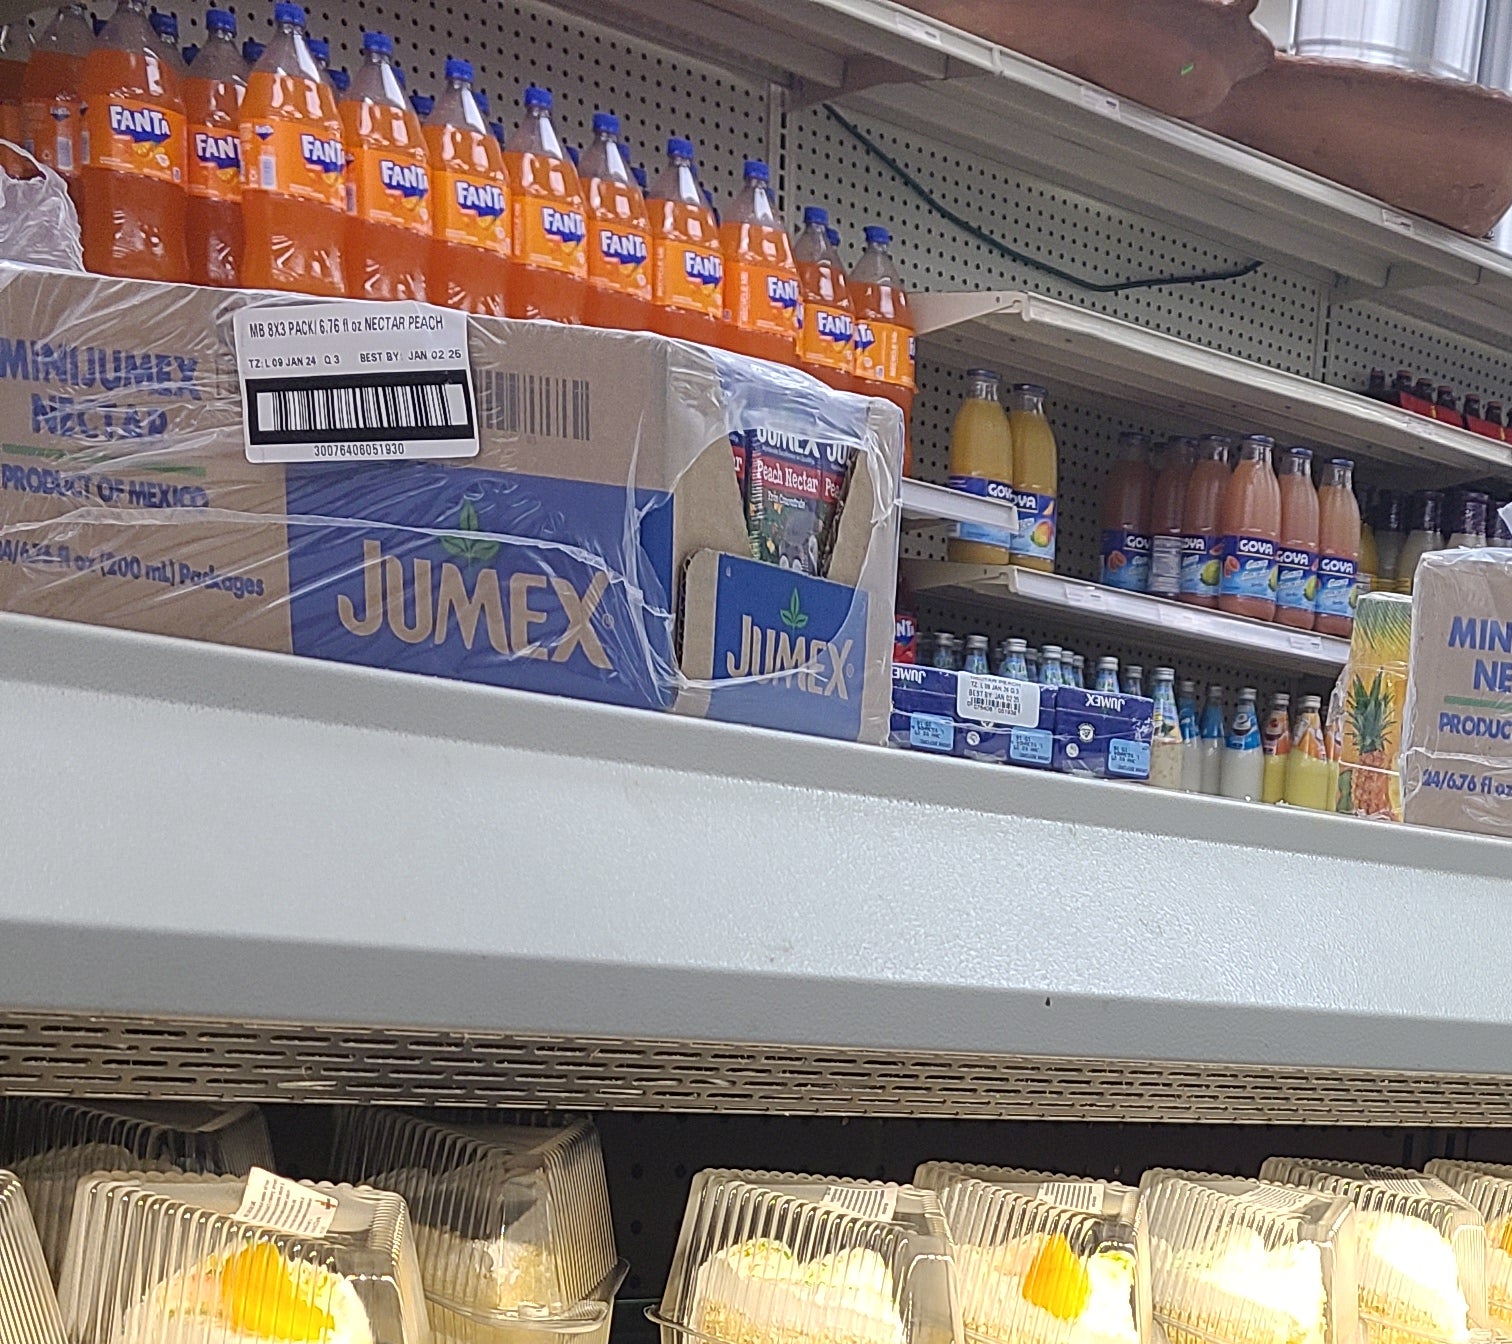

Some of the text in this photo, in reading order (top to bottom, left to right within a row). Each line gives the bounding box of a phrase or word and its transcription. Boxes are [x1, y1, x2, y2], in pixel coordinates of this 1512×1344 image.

[109, 104, 170, 136] FANTA
[196, 133, 241, 160] FANT
[767, 275, 799, 301] FANT
[249, 323, 266, 339] MB
[267, 321, 287, 338] 8X3
[319, 318, 341, 335] 6.76
[351, 320, 363, 333] oz
[364, 316, 406, 332] NECTAR
[408, 315, 444, 331] PEACH
[817, 310, 852, 336] FANT
[285, 356, 304, 367] JAN
[305, 356, 317, 366] 24
[323, 355, 332, 366] Q
[333, 354, 340, 365] 3
[360, 351, 384, 363] BEST
[408, 349, 428, 361] JAN
[431, 350, 446, 360] 02
[2, 463, 210, 508] PRODUCT OF MEXICO
[756, 459, 784, 485] Peach
[785, 466, 818, 493] Nectar
[1238, 538, 1274, 556] GOYA
[1276, 550, 1309, 566] GOYA
[99, 553, 141, 581] (200
[145, 559, 175, 586] mL)
[1320, 558, 1354, 575] GOYA
[338, 539, 614, 671] JUMEX
[727, 614, 854, 700] JUMEX
[1085, 692, 1126, 712] JUMEX
[1422, 768, 1478, 793] 24/6.76
